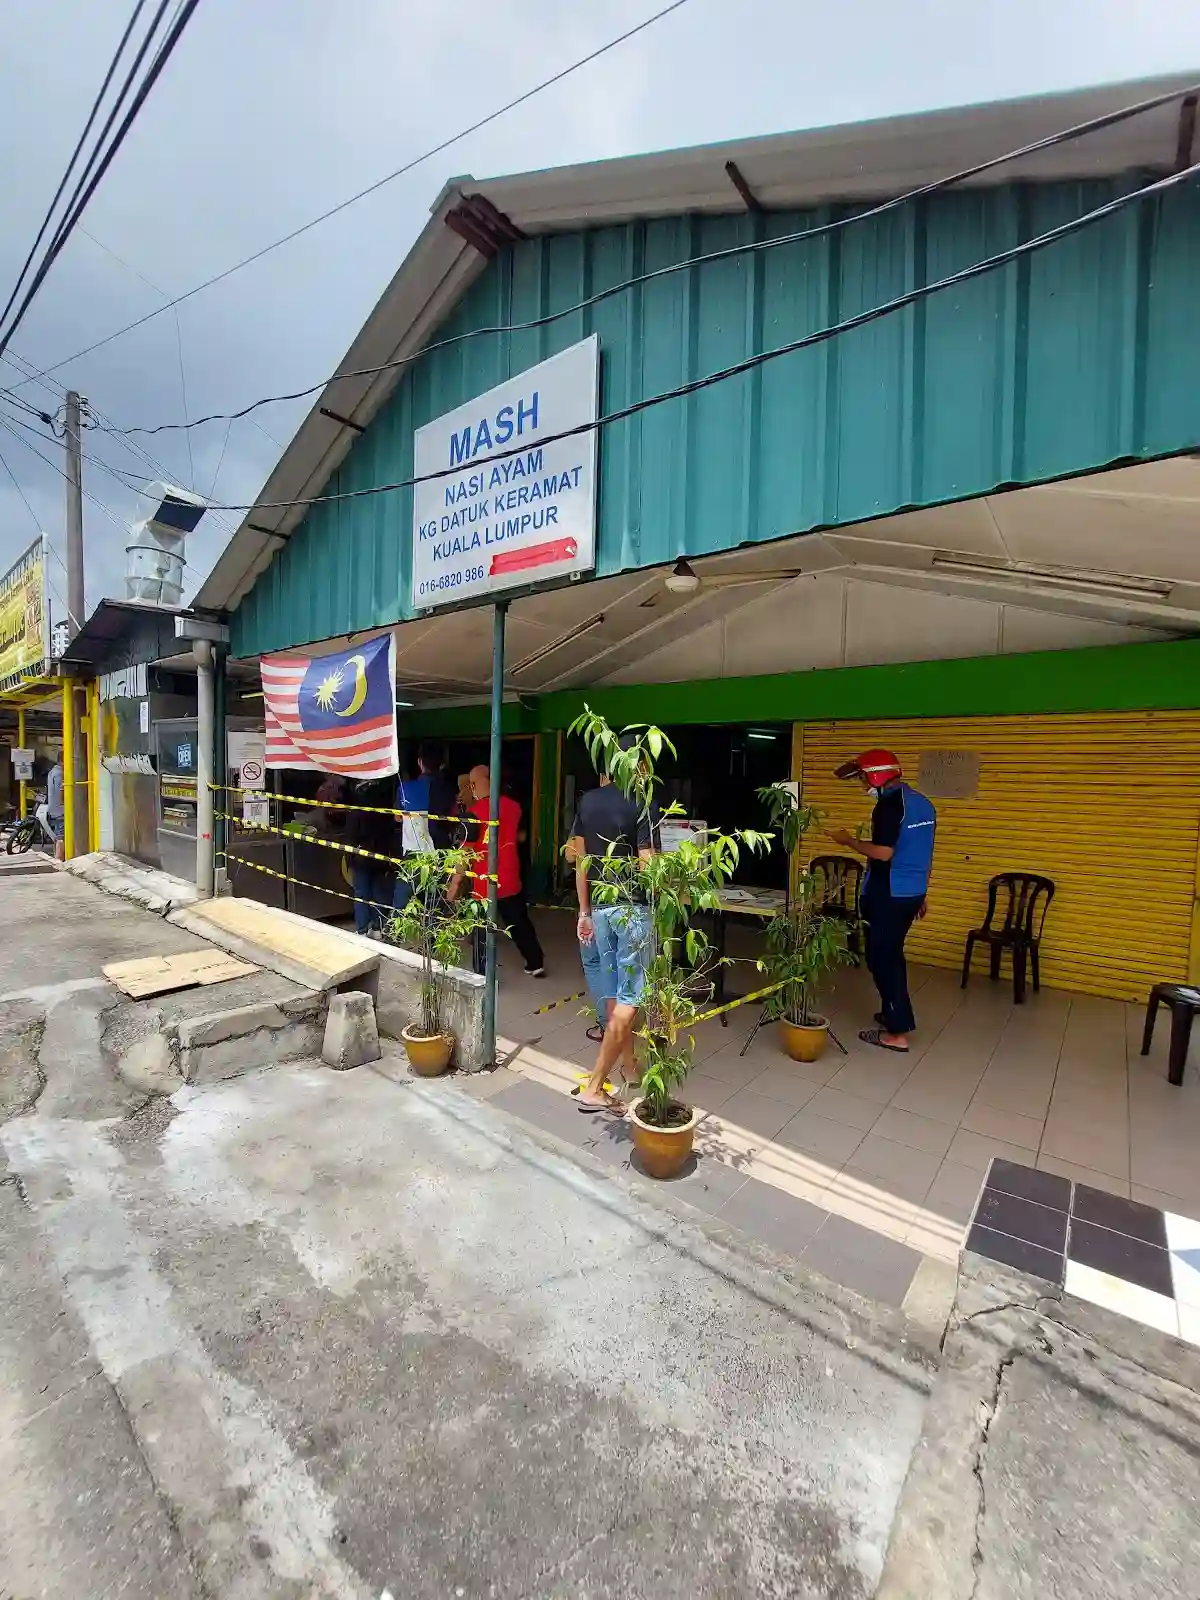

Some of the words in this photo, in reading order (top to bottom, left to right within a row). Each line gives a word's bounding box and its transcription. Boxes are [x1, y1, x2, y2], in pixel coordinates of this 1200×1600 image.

[449, 391, 539, 466] MASH
[419, 521, 437, 542] KG
[441, 499, 489, 534] DATUK
[494, 466, 582, 514] KERAMAT
[445, 472, 484, 507] NASI
[489, 449, 543, 490] AYAM
[433, 534, 481, 562] KUALA
[484, 505, 558, 545] LUMPUR
[419, 571, 462, 595] 016-6820
[464, 565, 484, 584] 986
